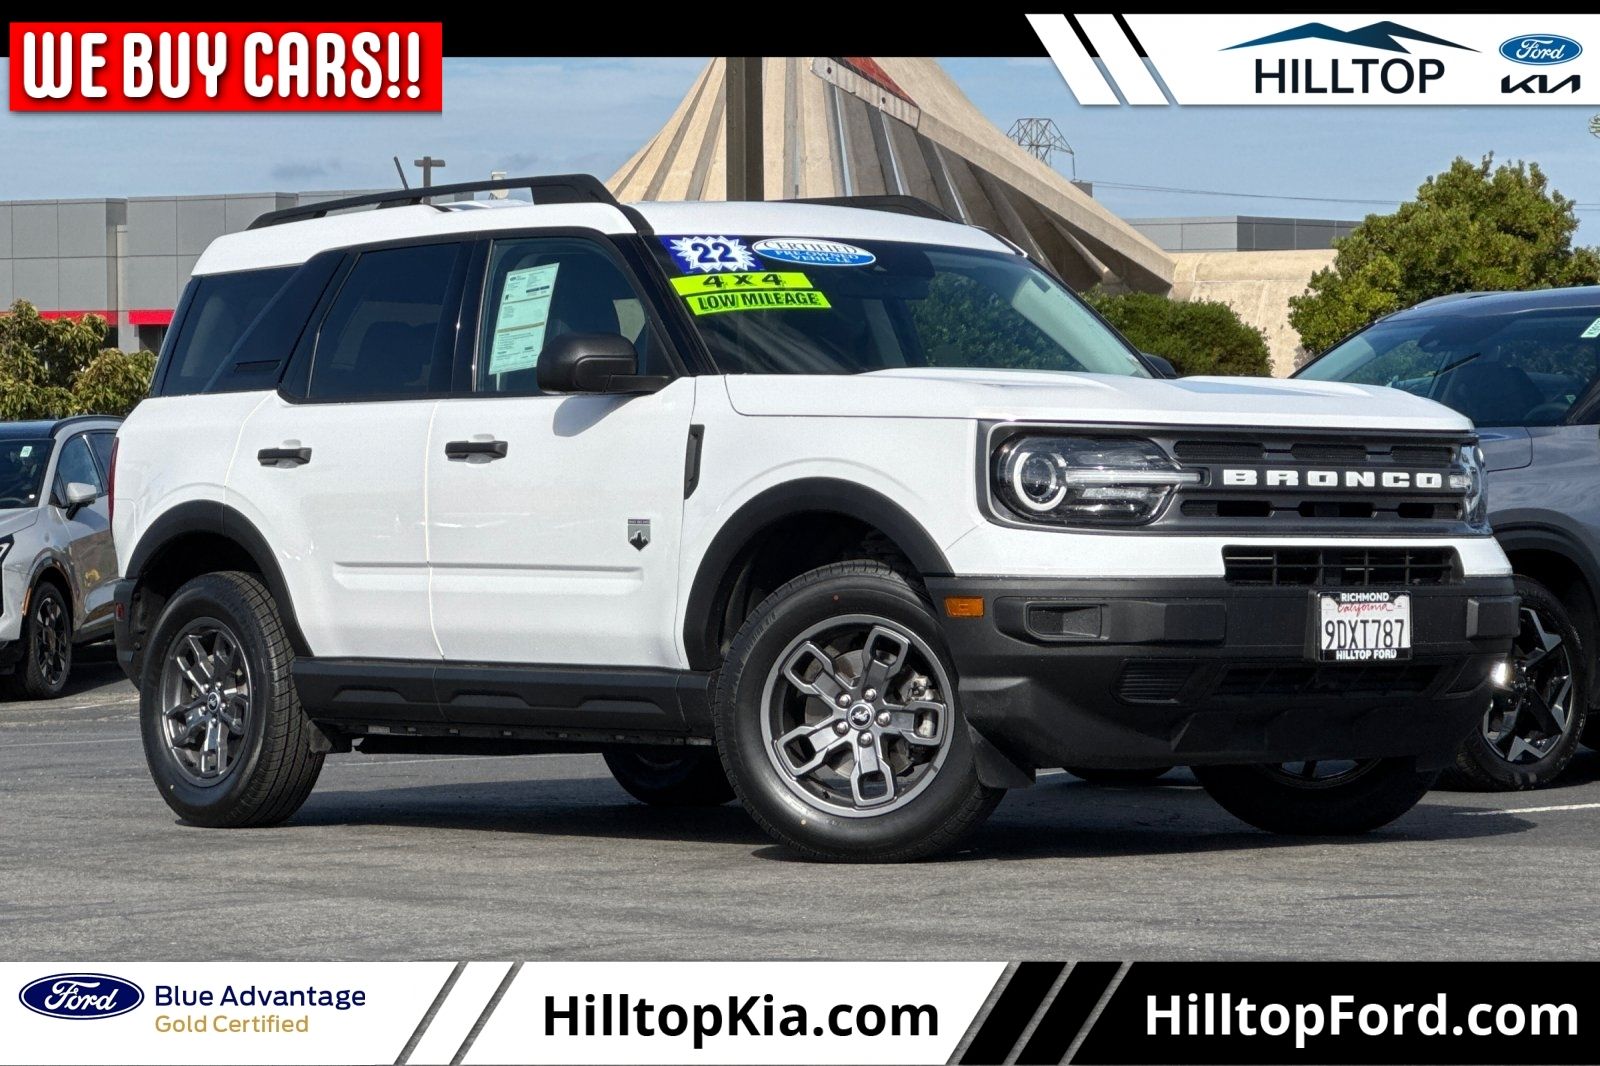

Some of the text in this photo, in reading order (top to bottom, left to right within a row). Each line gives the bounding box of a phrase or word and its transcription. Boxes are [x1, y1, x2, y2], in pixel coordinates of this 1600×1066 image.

[690, 242, 739, 264] 22
[764, 241, 858, 254] CERTIFIED
[792, 254, 853, 264] VEHICLE
[698, 291, 820, 310] LOW MILEAGE
[1223, 469, 1443, 488] BRONCO
[1341, 592, 1390, 602] RICHMOND
[1325, 619, 1405, 649] 9DXT787
[1336, 649, 1398, 660] HILLTOP FORD
